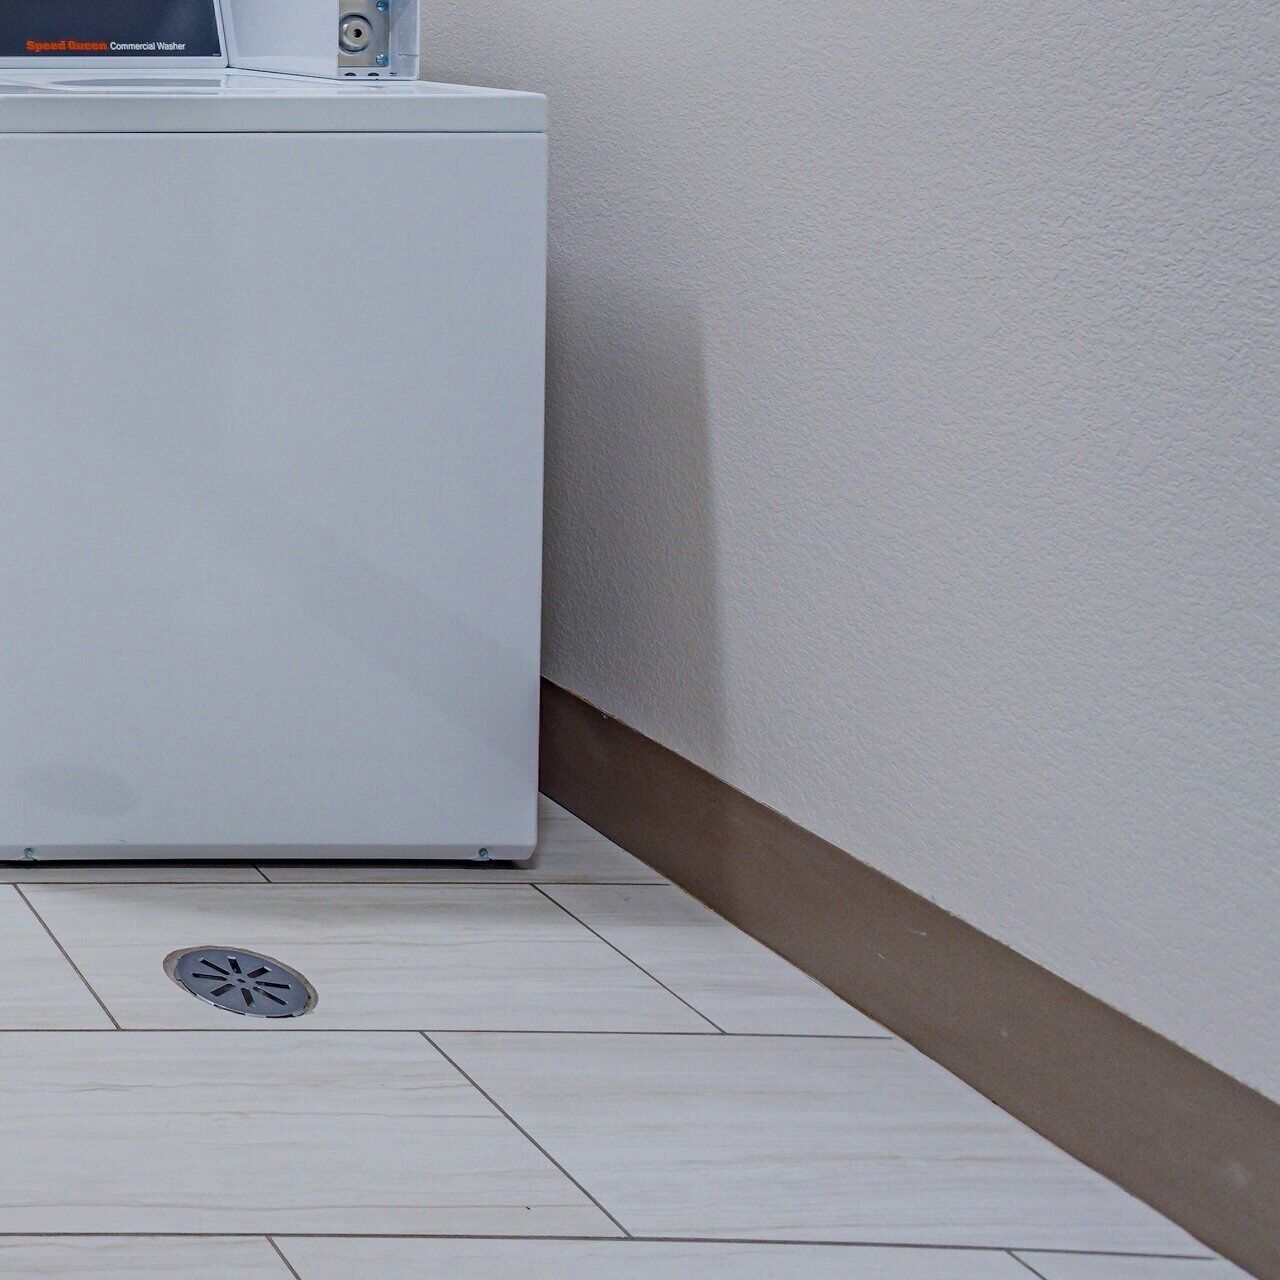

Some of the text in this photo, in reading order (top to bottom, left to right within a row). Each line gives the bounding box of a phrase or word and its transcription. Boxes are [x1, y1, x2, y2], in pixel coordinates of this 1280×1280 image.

[26, 40, 66, 52] Speed
[109, 41, 155, 51] Commercial
[157, 41, 186, 51] Washer
